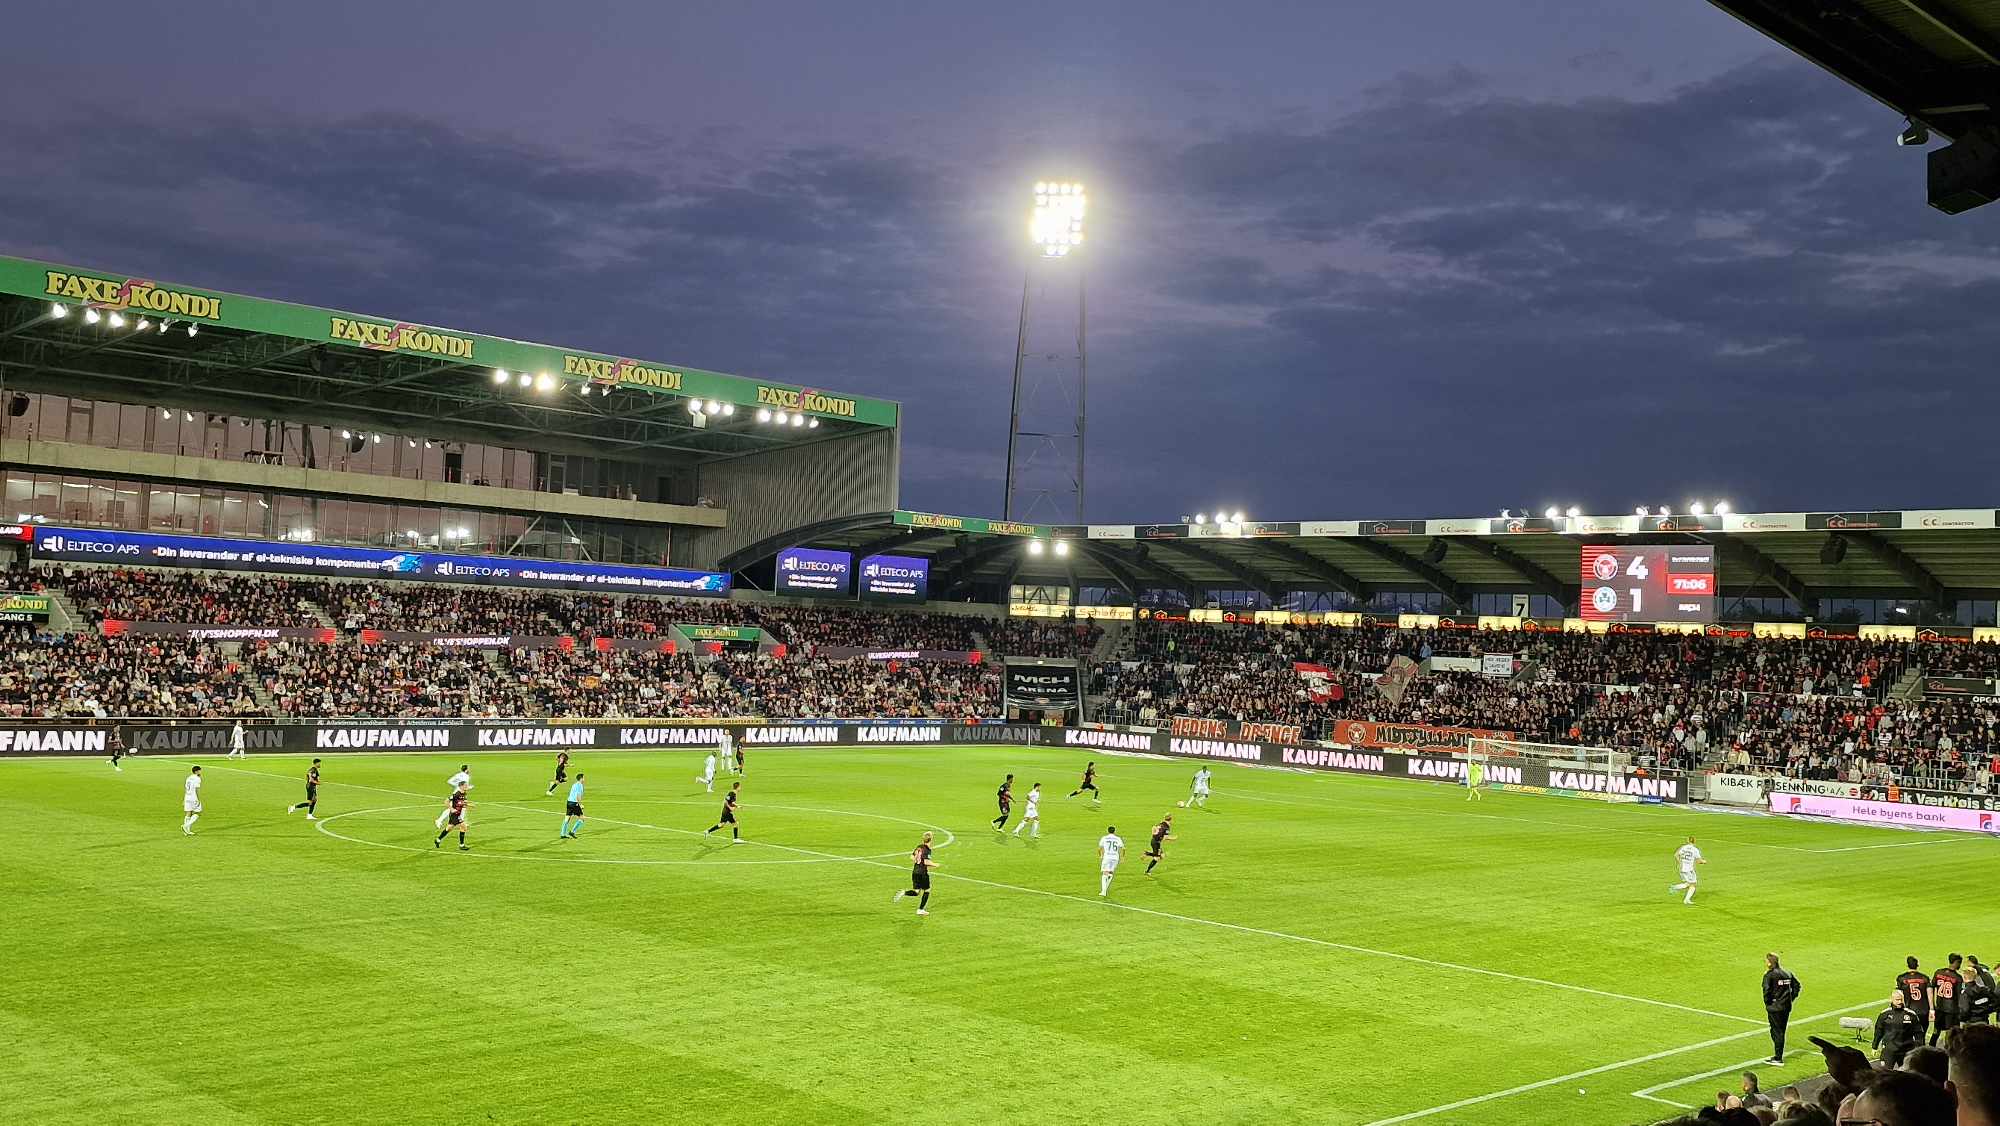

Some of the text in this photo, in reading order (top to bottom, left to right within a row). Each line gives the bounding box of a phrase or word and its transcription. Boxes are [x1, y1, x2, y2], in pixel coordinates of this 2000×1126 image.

[46, 271, 222, 320] FAXE KONDI
[331, 317, 474, 358] FAXE KONDI
[564, 355, 681, 390] FAXE KONDI
[757, 386, 856, 416] FAXE KONDI
[911, 514, 962, 528] FAXE KONDI
[988, 522, 1035, 534] FAXE KONDI
[67, 540, 140, 555] ELTECO APS
[455, 565, 510, 577] ELTECO APS
[799, 561, 846, 572] ELTECO APS
[880, 567, 924, 578] ELTECO APS
[1626, 556, 1649, 579] 4
[6, 598, 48, 610] KONDI
[1629, 588, 1642, 612] 1
[1515, 603, 1526, 616] 7
[1013, 673, 1071, 684] MCH
[1016, 685, 1069, 693] ARENA
[316, 729, 450, 747] KAUFMANN
[478, 728, 596, 746] KAUFMANN
[620, 728, 724, 745] KAUFMANN
[746, 726, 838, 743] KAUFMANN
[857, 726, 941, 742] KAUFMANN
[953, 726, 1042, 742] KAUFMANN
[1171, 716, 1302, 745] HEDENS DRENGE
[0, 731, 105, 751] FMANN
[133, 730, 284, 750] KAUFMNN
[1065, 730, 1152, 750] KAUFMANN
[1169, 738, 1262, 760] KAUFMANN
[1282, 747, 1384, 771] KAUFMANN
[1550, 770, 1677, 798] KAUFMANN
[1720, 777, 1754, 788] KIBÆK
[1853, 805, 1946, 823] Hele byens bank
[1106, 840, 1118, 852] 76
[1909, 982, 1922, 1001] 5
